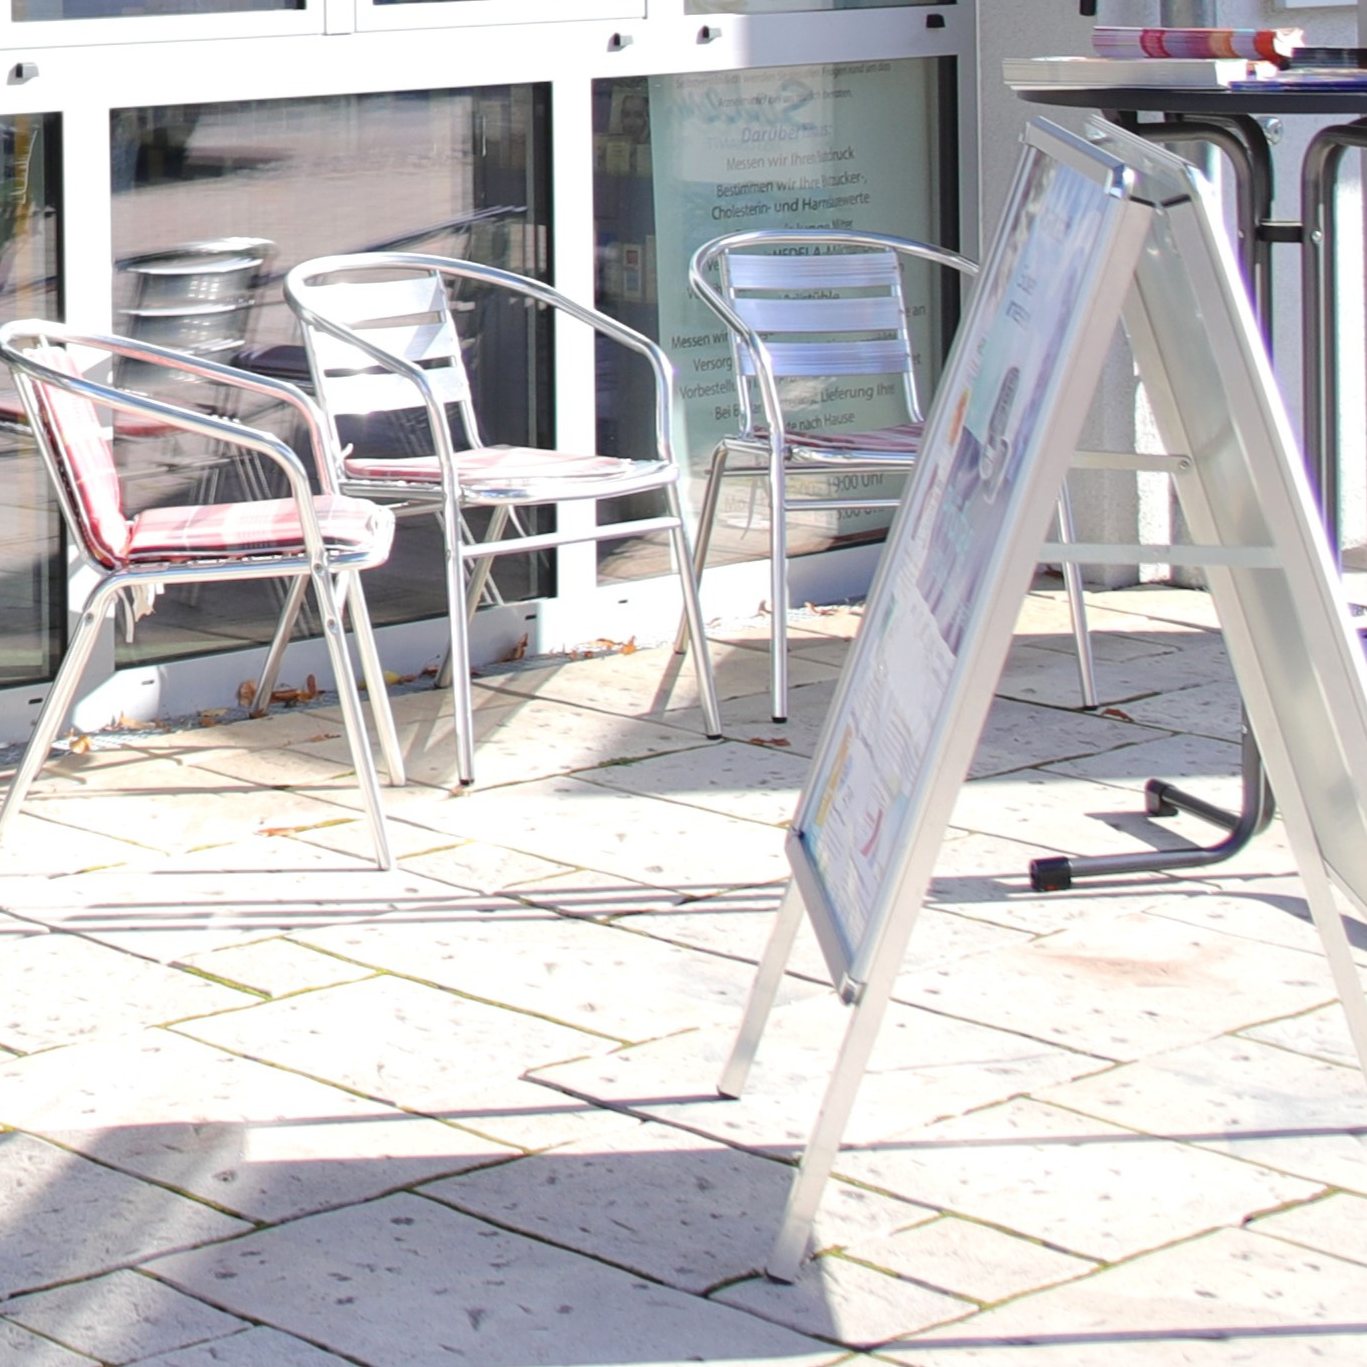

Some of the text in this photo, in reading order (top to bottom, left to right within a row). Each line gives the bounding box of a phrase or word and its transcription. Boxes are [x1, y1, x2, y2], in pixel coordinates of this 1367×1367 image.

[726, 155, 765, 171] Messen
[768, 152, 788, 168] wir
[716, 182, 774, 198] Bestimmen
[777, 179, 796, 192] wir
[711, 202, 772, 221] Cholesterin-
[774, 198, 800, 213] und
[671, 333, 710, 349] Messen
[693, 355, 733, 372] Versorg
[678, 380, 735, 399] Vorbestell
[715, 406, 731, 420] Bei
[821, 385, 874, 403] Lieferung
[800, 418, 821, 432] nach
[824, 412, 855, 427] Hause
